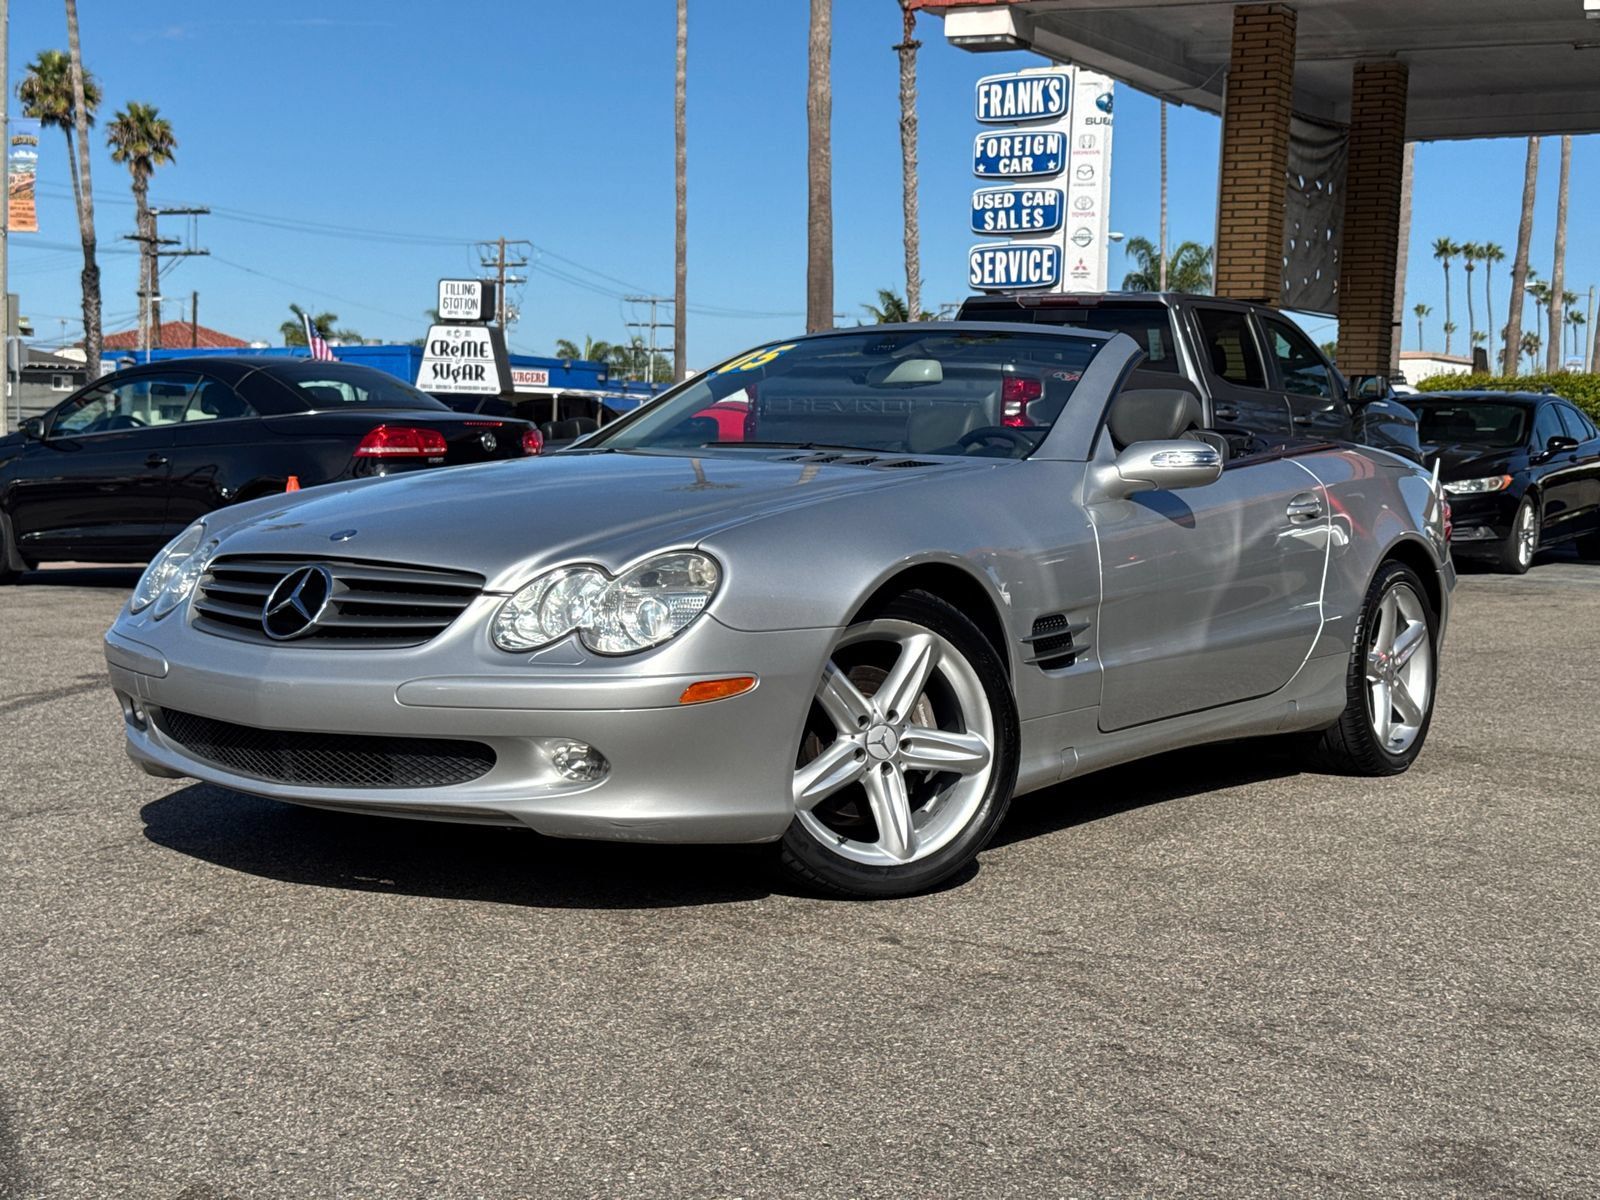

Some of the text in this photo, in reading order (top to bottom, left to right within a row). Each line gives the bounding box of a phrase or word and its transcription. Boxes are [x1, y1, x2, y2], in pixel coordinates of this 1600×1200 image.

[979, 78, 1060, 118] FRANK'S
[1085, 116, 1113, 126] SUB
[975, 135, 1059, 158] FOREIGN
[999, 158, 1033, 174] CAR
[972, 190, 1057, 210] USED CAR
[984, 208, 1044, 231] SALES
[970, 250, 1054, 284] SERVICE
[512, 371, 547, 383] URGERS
